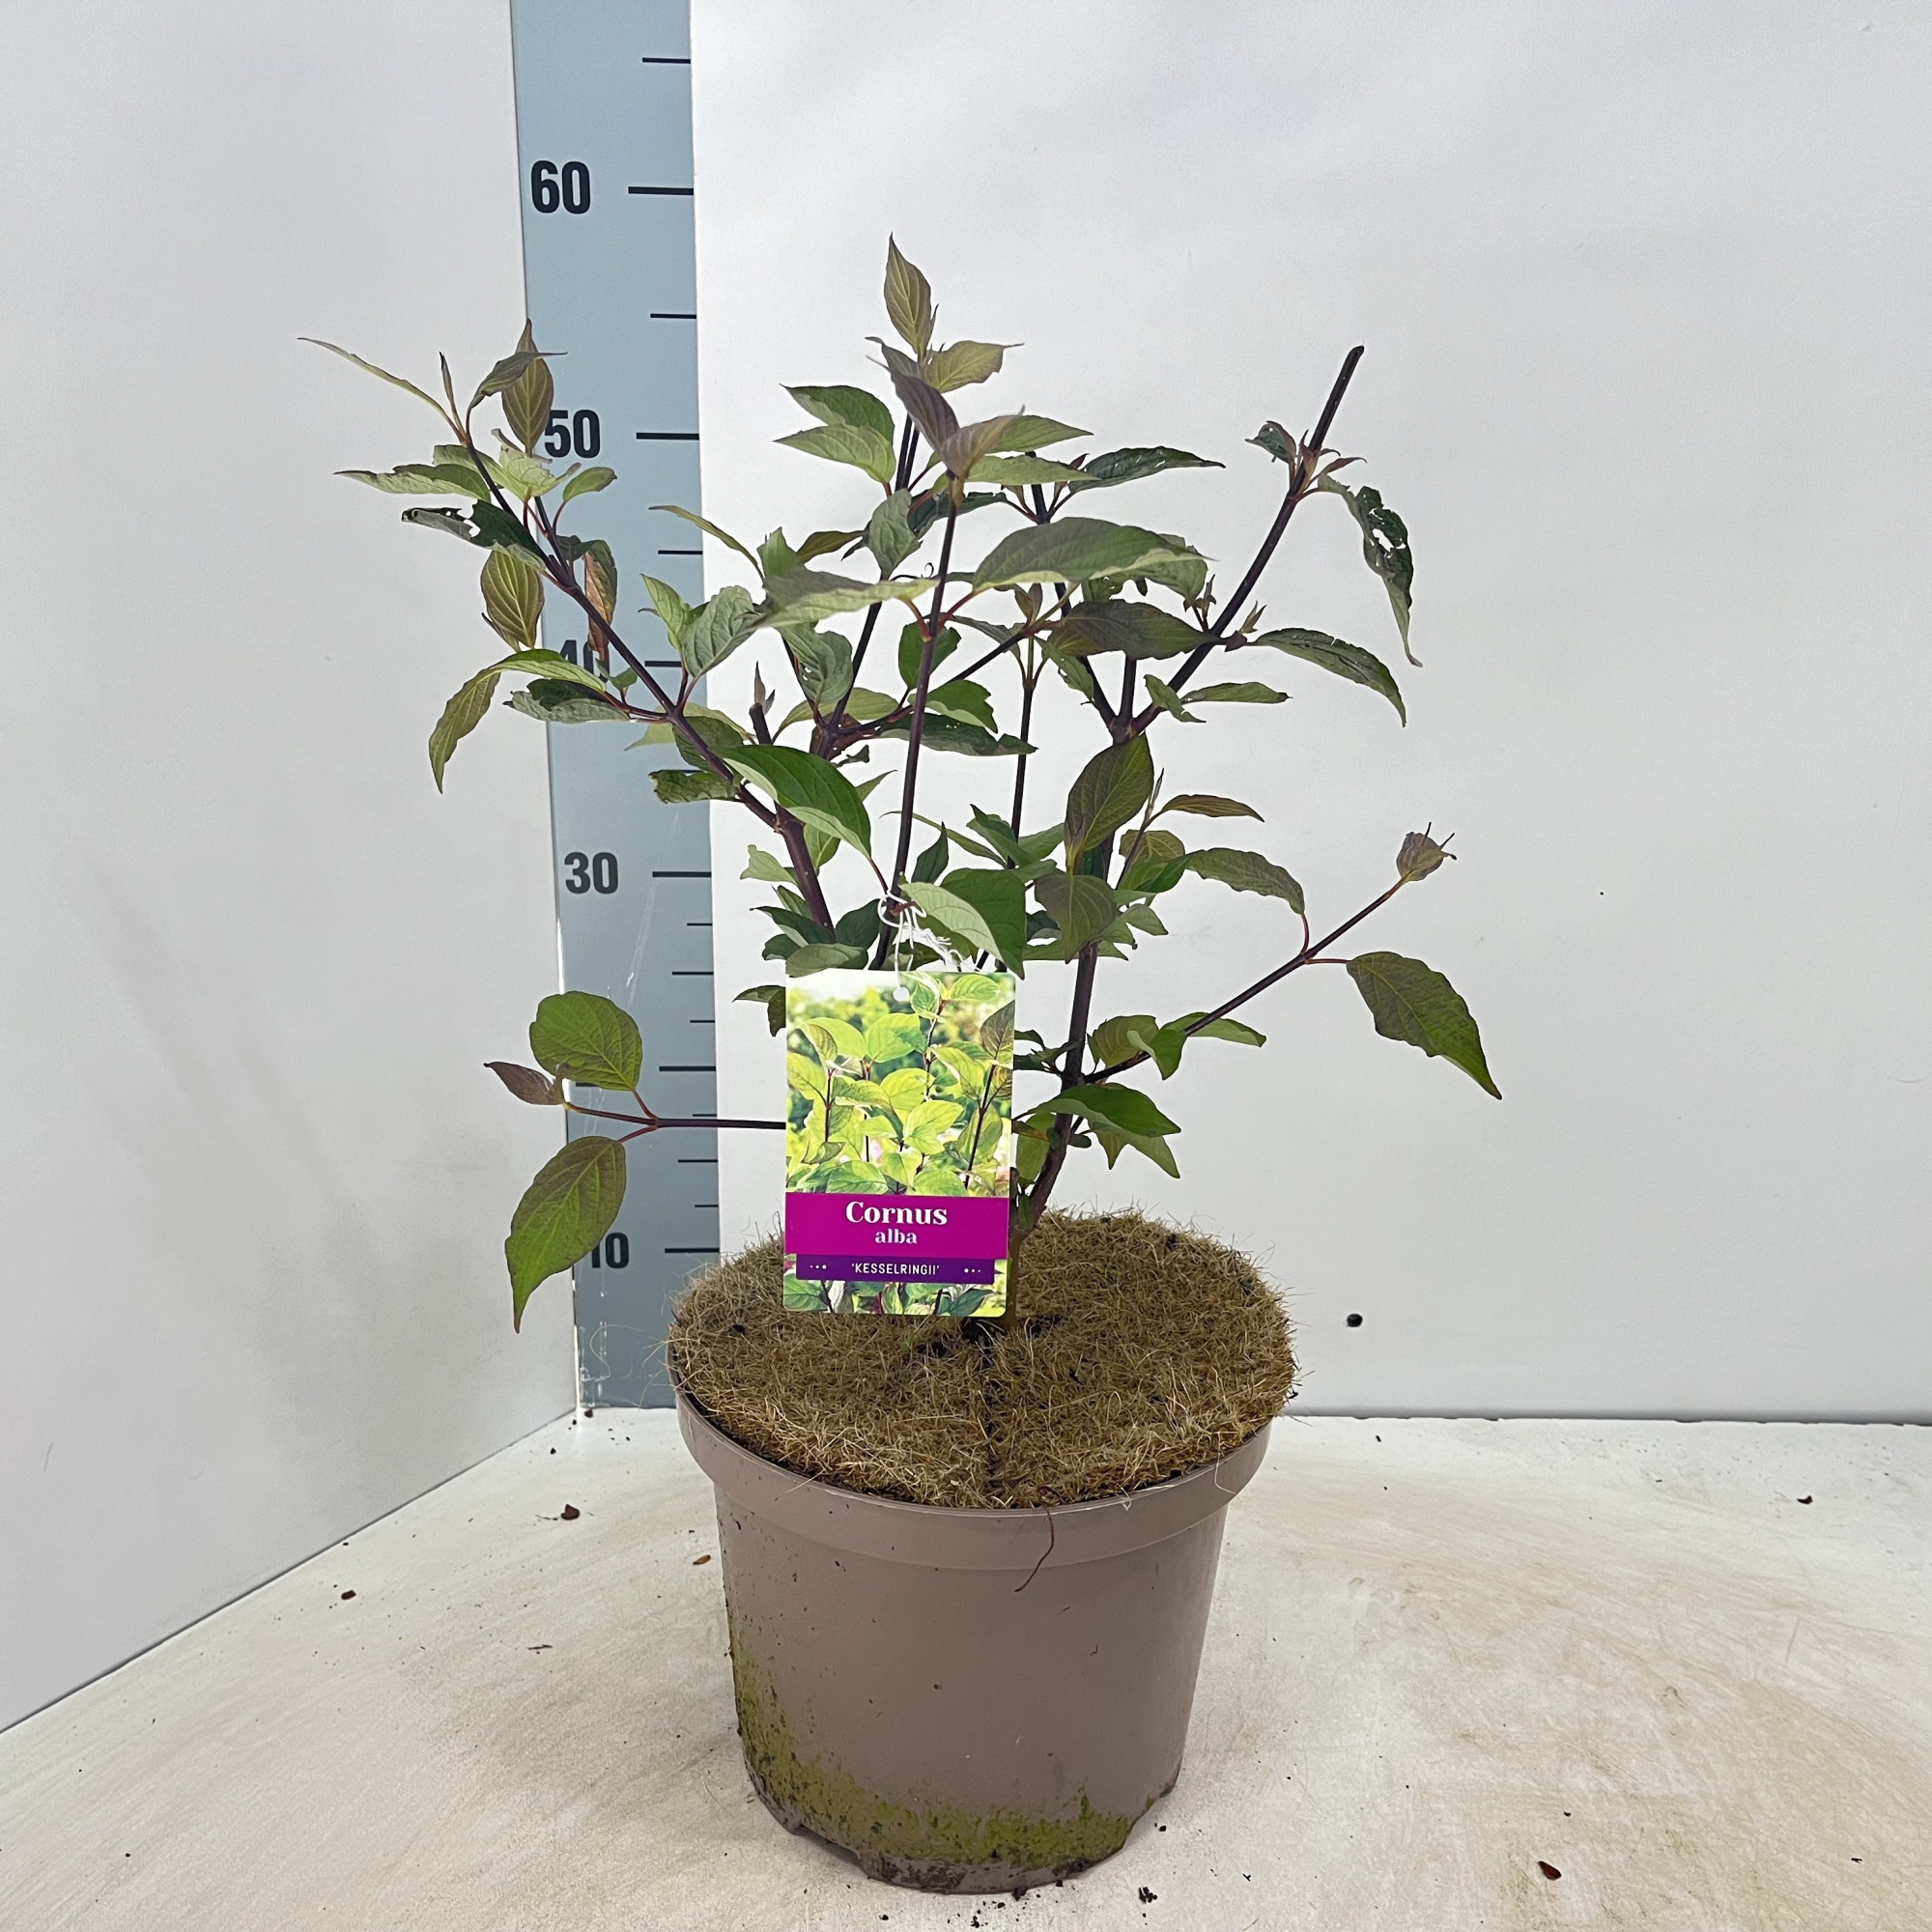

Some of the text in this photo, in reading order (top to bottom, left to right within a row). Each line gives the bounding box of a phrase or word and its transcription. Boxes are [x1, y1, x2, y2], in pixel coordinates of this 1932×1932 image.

[530, 159, 591, 214] 60
[544, 409, 601, 459] 50
[564, 851, 619, 895] 30
[845, 1201, 948, 1226] Cornus
[874, 1228, 918, 1245] alba
